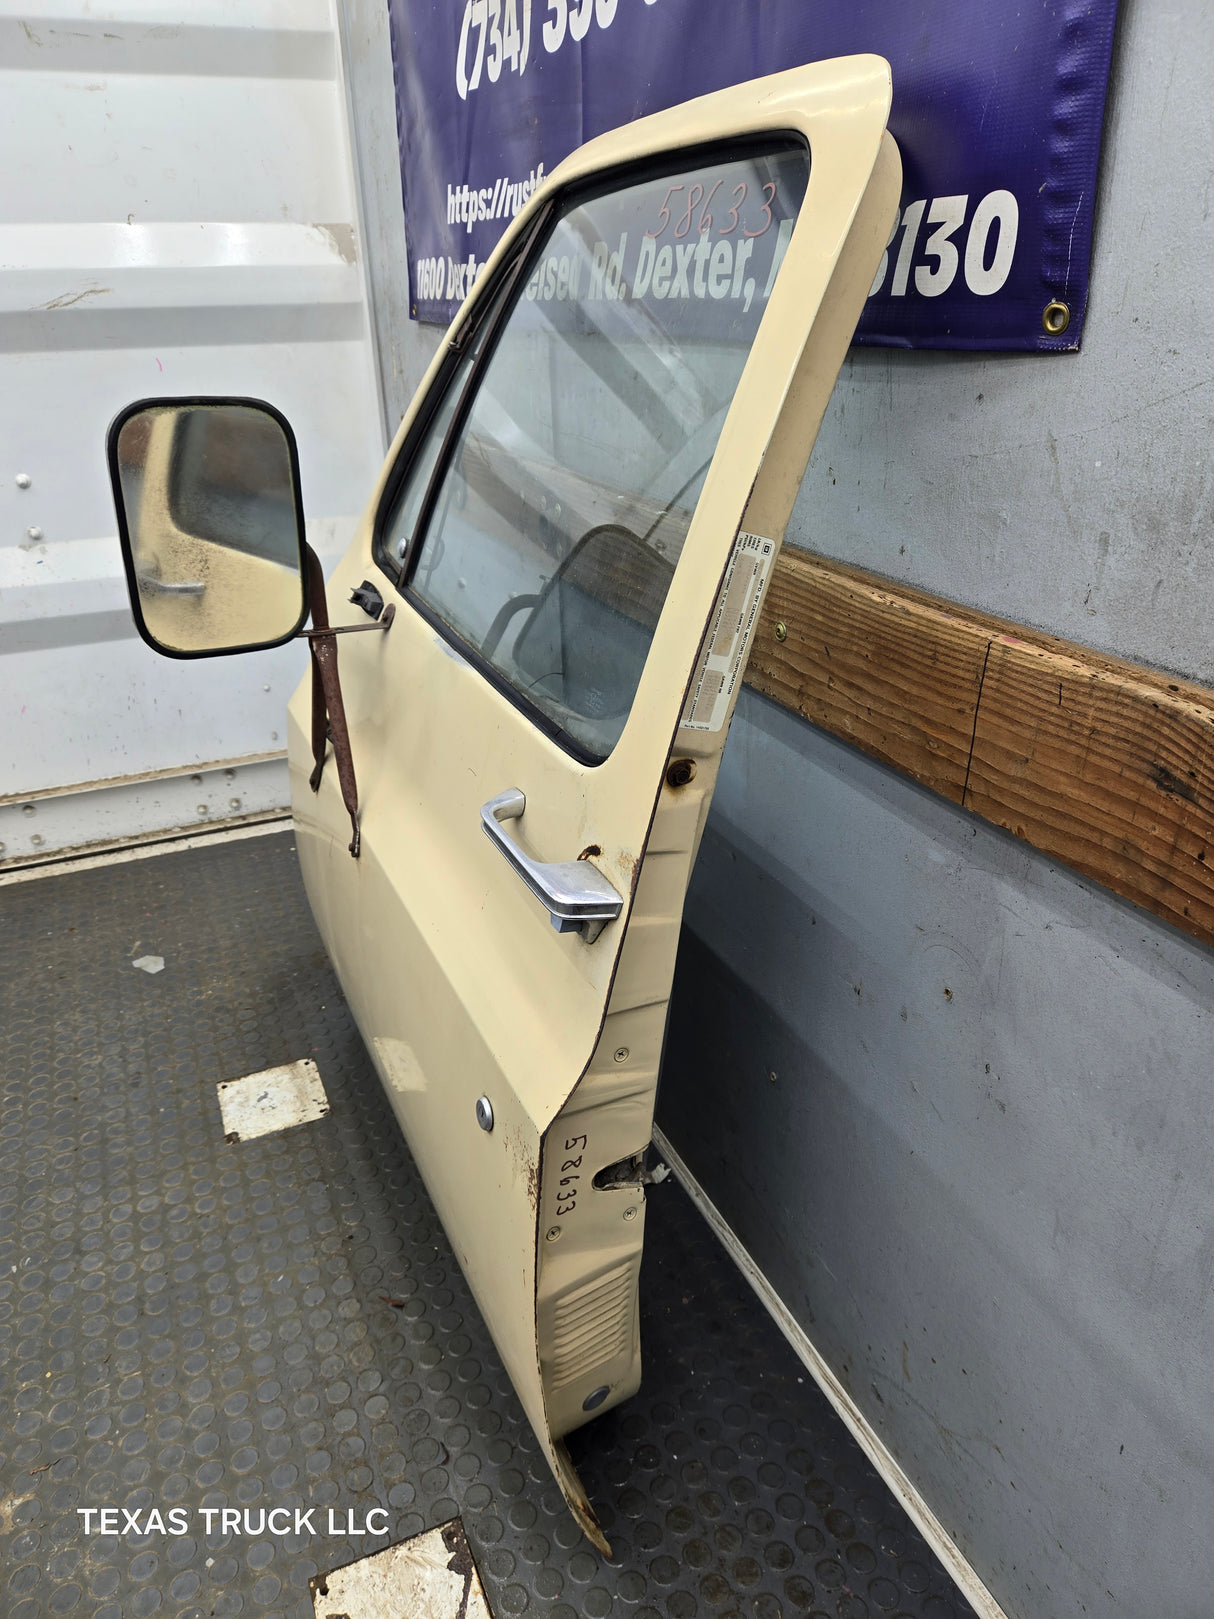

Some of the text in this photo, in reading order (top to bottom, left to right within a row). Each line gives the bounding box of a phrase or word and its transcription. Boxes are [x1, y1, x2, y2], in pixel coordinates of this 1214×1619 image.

[456, 0, 531, 100] (734)
[447, 163, 547, 233] https://rustf
[645, 179, 777, 238] 58633
[417, 256, 445, 300] 11600
[588, 231, 627, 300] Rd.
[632, 229, 756, 313] Dexter,
[867, 189, 1019, 298] 130
[556, 1134, 587, 1216] 58633
